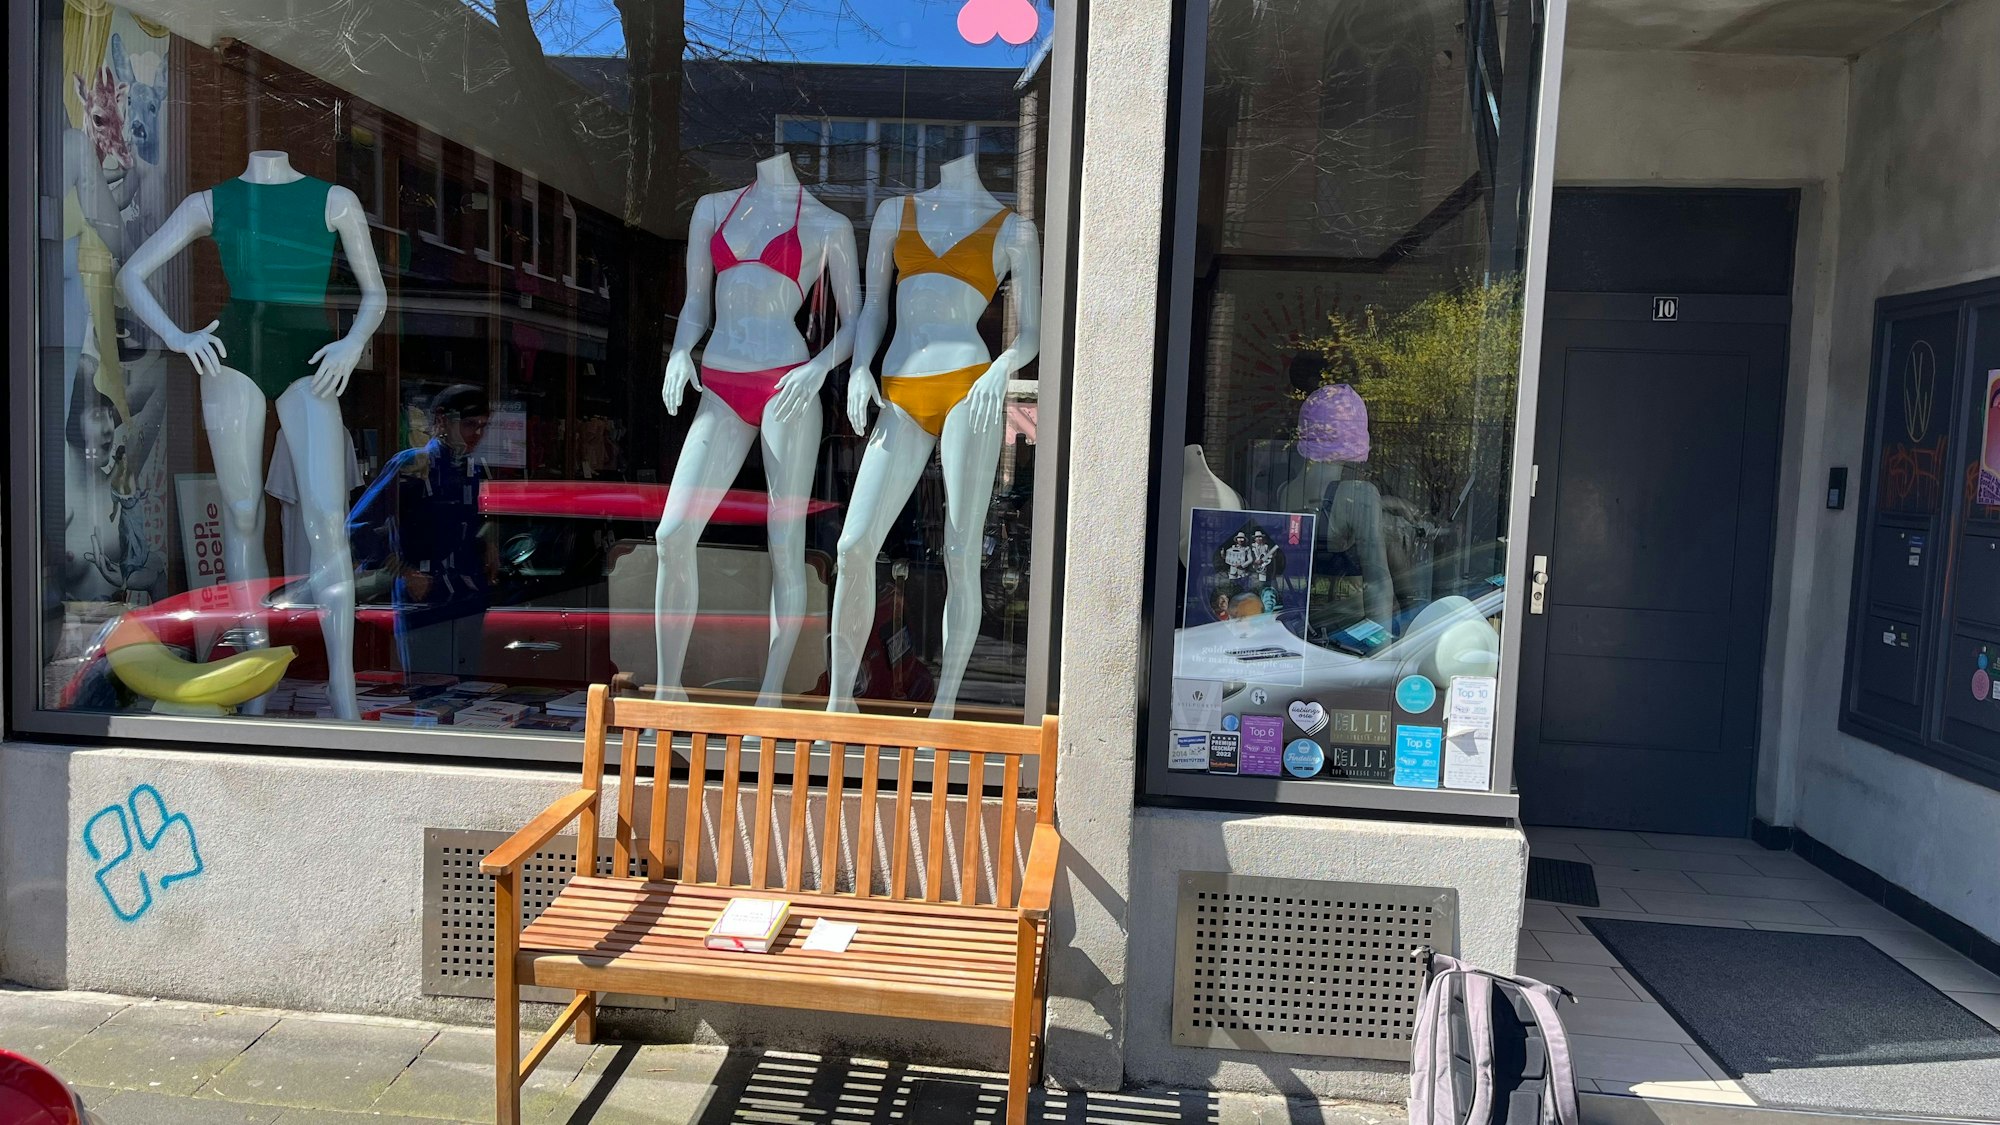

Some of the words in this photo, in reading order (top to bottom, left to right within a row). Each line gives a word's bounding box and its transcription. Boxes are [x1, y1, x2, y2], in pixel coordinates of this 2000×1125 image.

[1656, 300, 1675, 317] 10
[193, 523, 214, 576] pop
[200, 587, 214, 611] le
[1457, 687, 1474, 699] Top
[1479, 689, 1488, 698] 10
[1334, 713, 1388, 733] ELLE
[1249, 727, 1266, 738] Top
[1268, 728, 1275, 737] 6
[1406, 738, 1423, 749] Top
[1425, 740, 1432, 748] 5
[1333, 748, 1387, 769] ELLE
